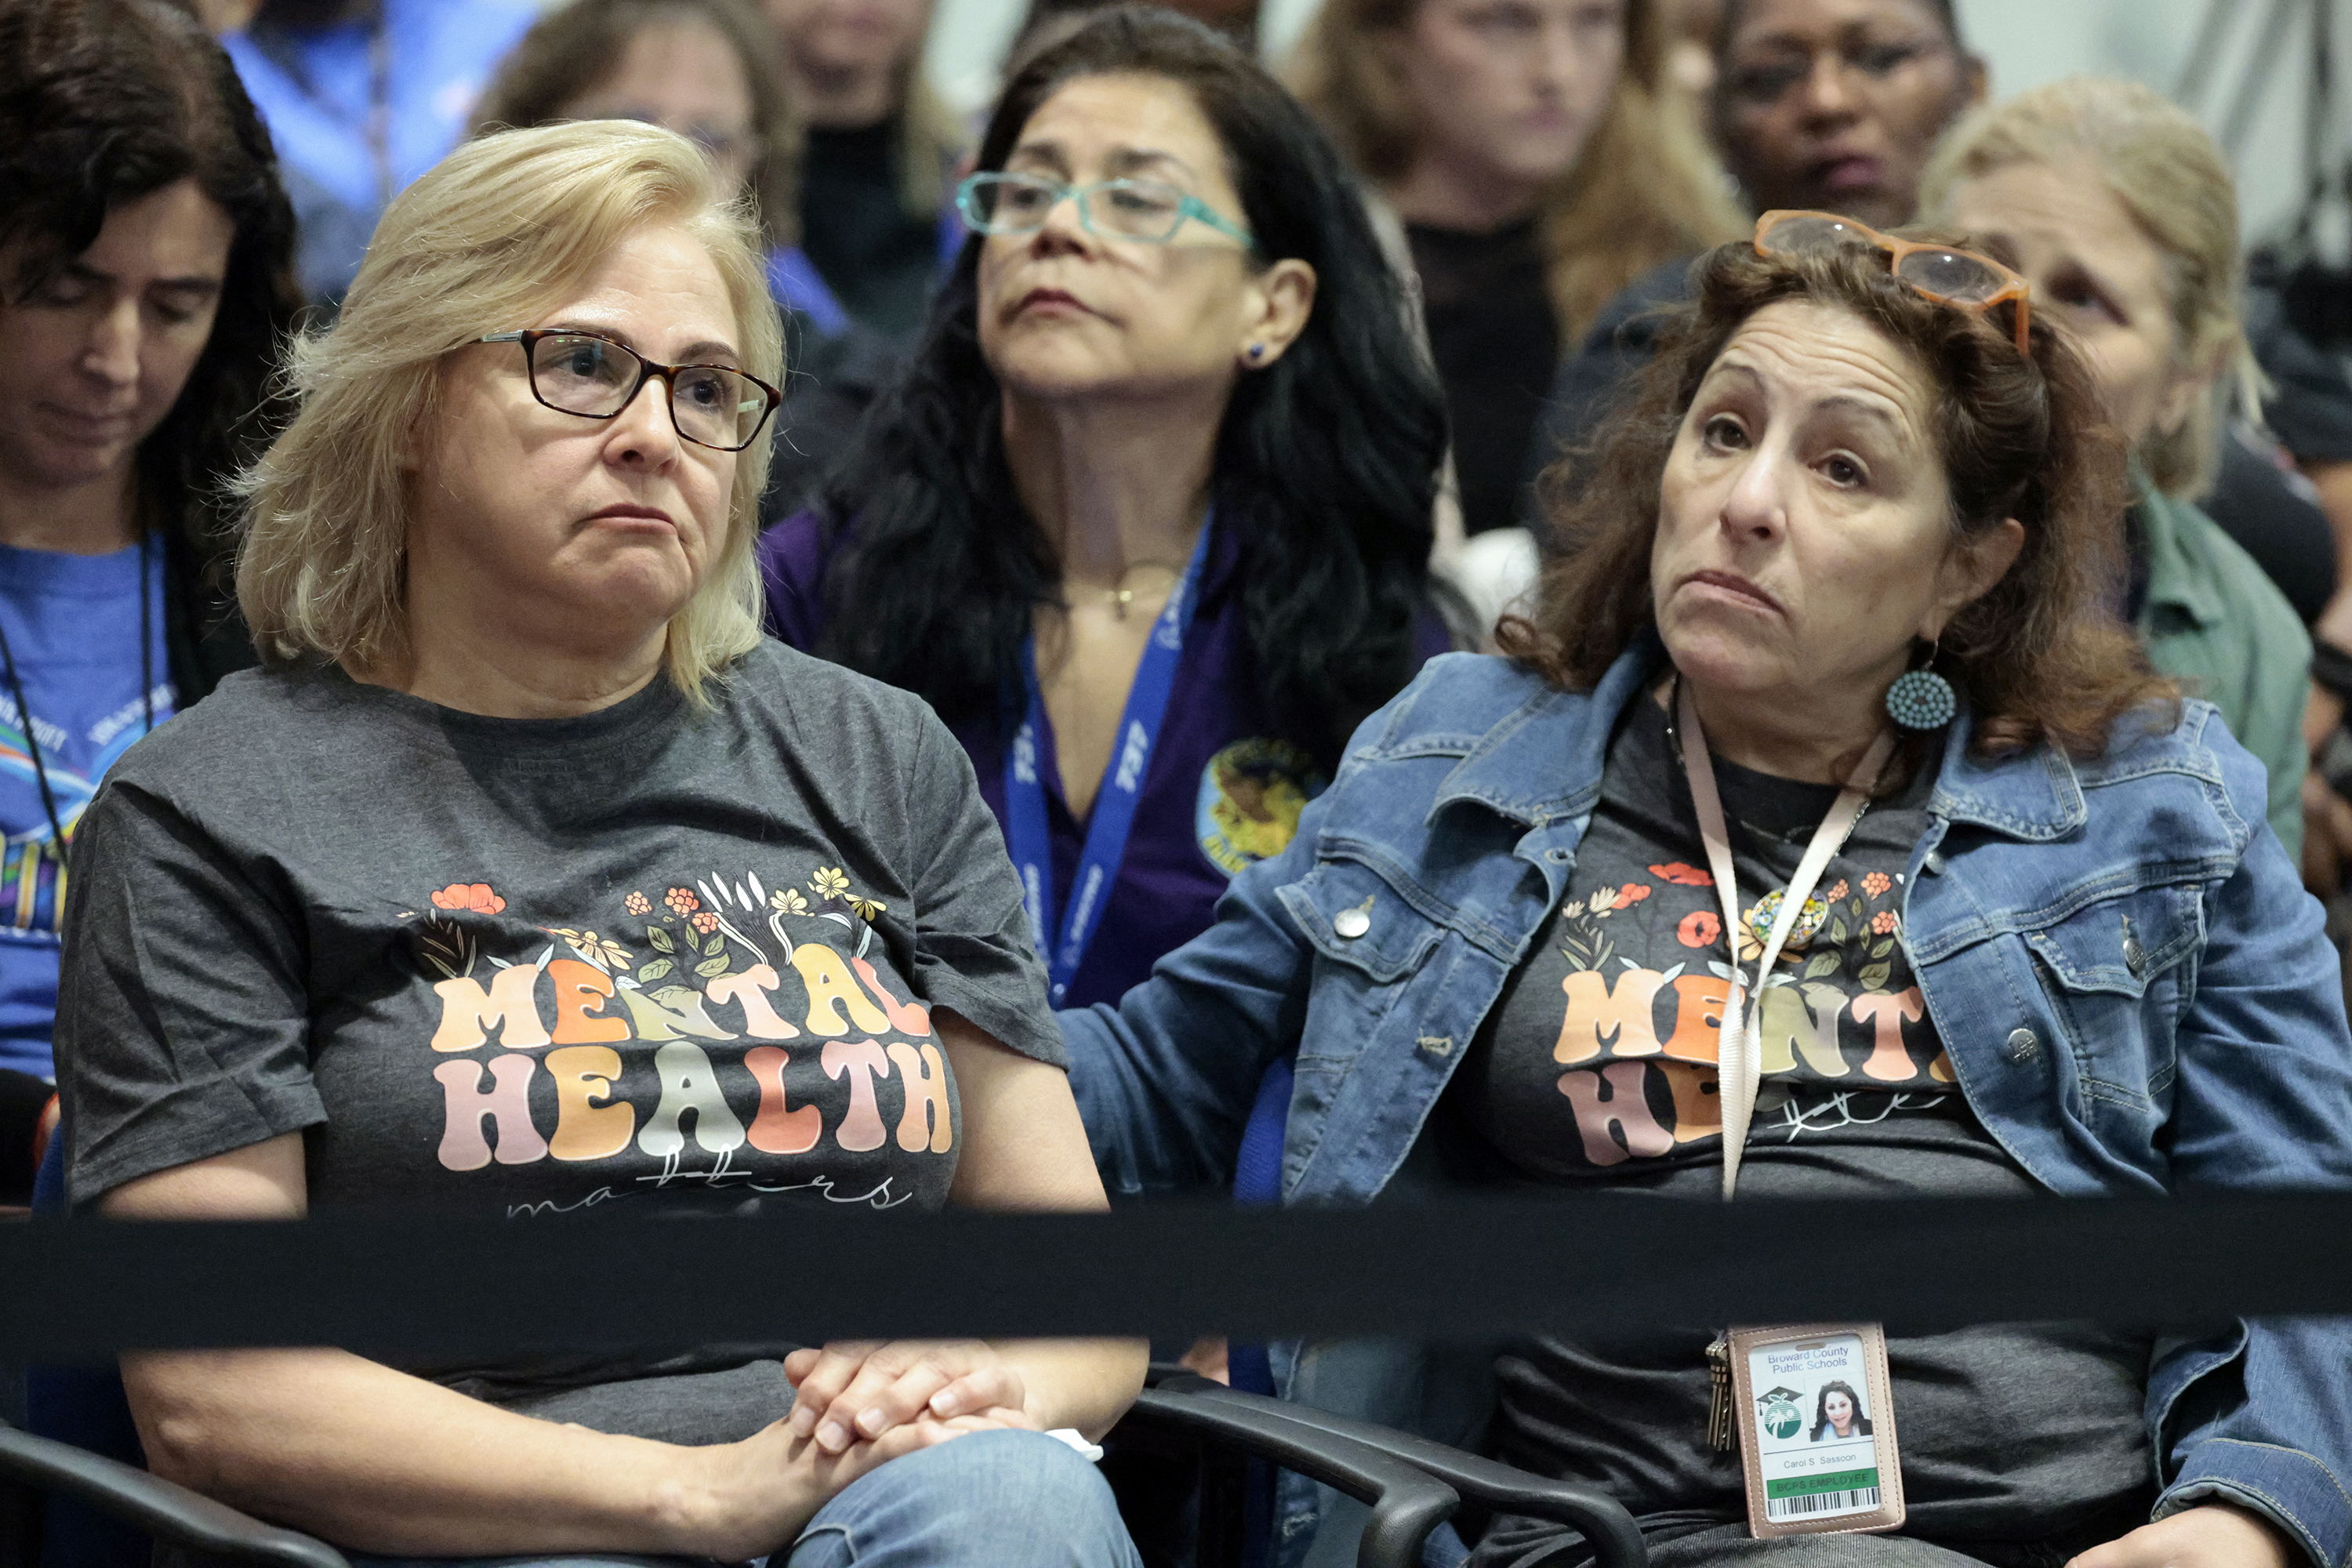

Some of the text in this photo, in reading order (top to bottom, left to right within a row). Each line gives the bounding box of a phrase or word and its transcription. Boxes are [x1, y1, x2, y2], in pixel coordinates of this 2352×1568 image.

[430, 943, 931, 1052] MENTAL
[1553, 969, 1958, 1081] MENT
[433, 1039, 952, 1171] HEALTH
[1768, 1347, 1849, 1364] Broward County
[1773, 1357, 1847, 1374] Public Schools
[1784, 1459, 1806, 1468] Carol
[1820, 1454, 1857, 1465] Sassoon
[1777, 1473, 1869, 1492] BCPS EMPLOYEE
